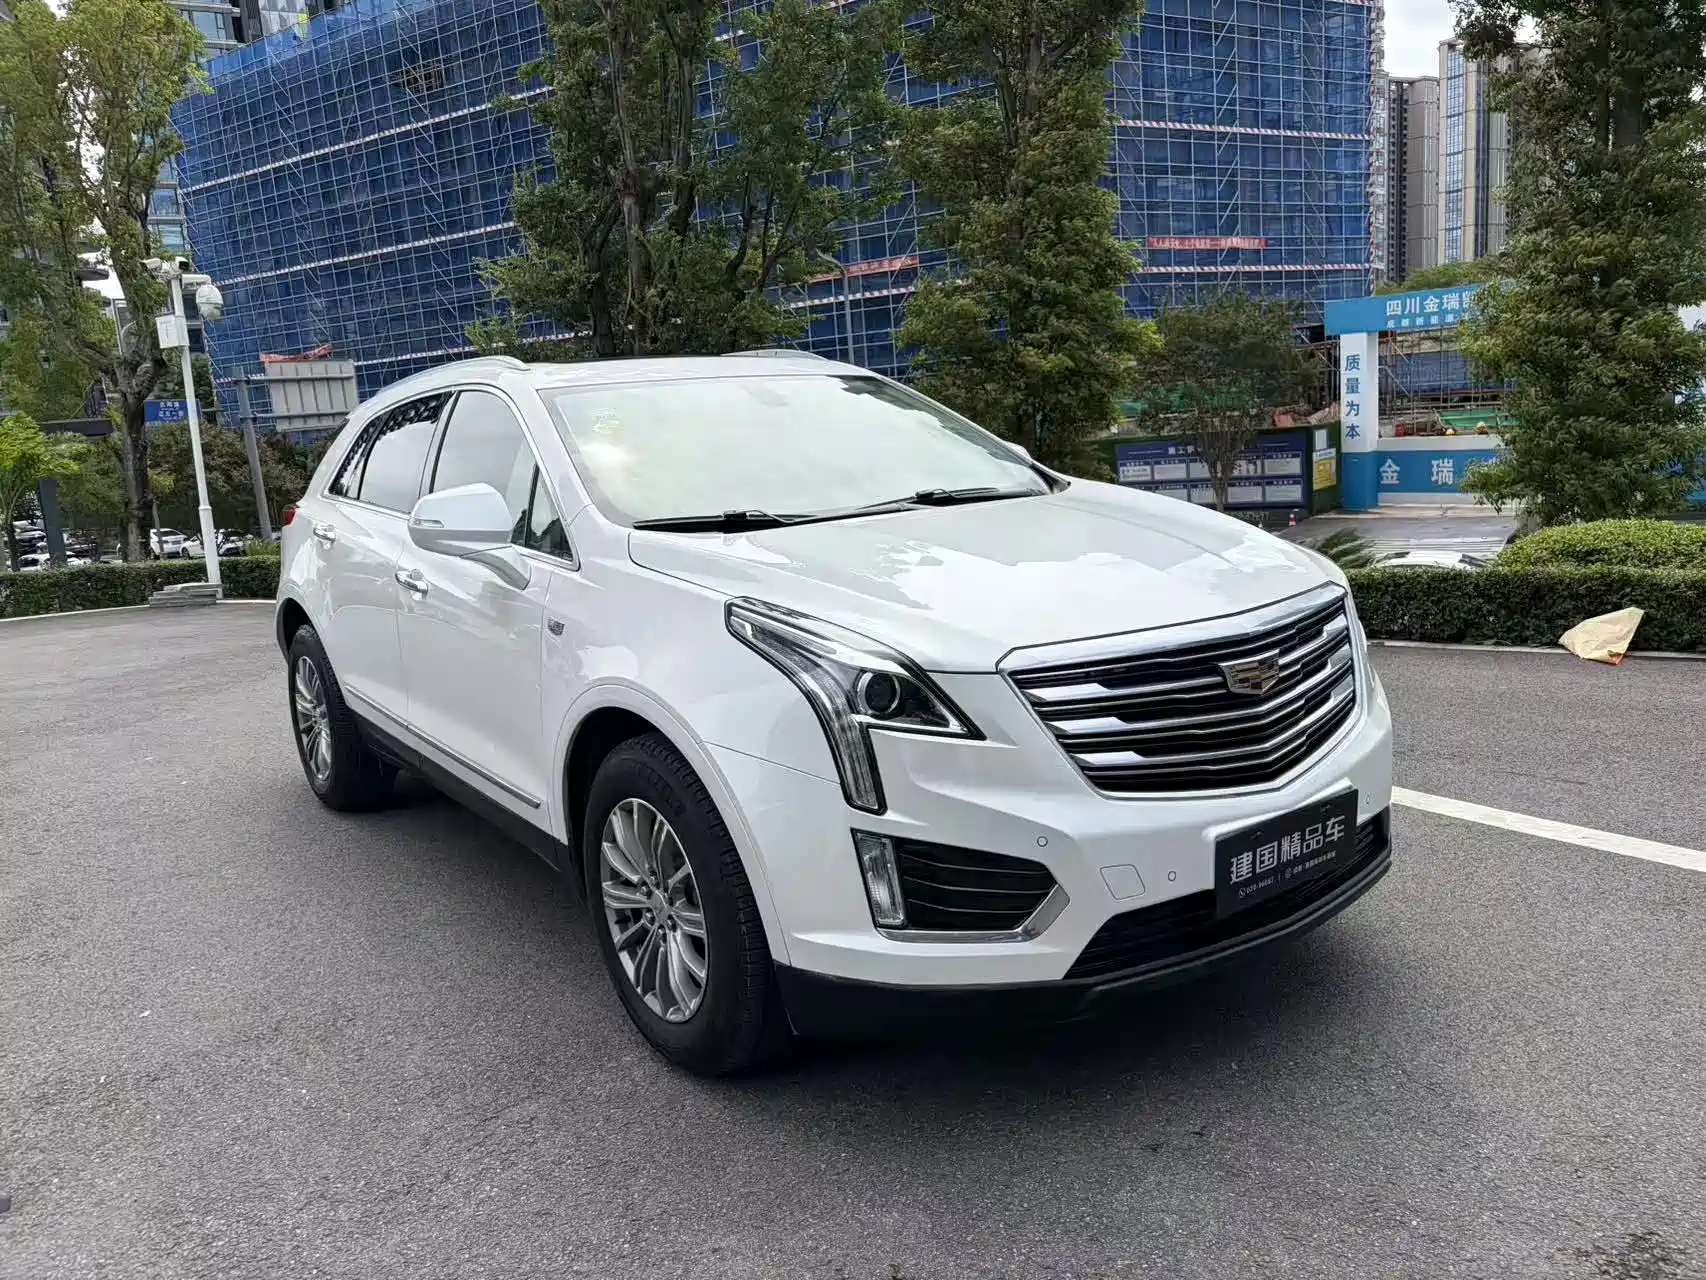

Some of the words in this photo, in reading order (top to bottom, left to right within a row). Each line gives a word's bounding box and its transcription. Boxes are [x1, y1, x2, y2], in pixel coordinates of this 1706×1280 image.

[1345, 354, 1361, 440] 质量为本
[1230, 815, 1345, 885] 建国精品车
